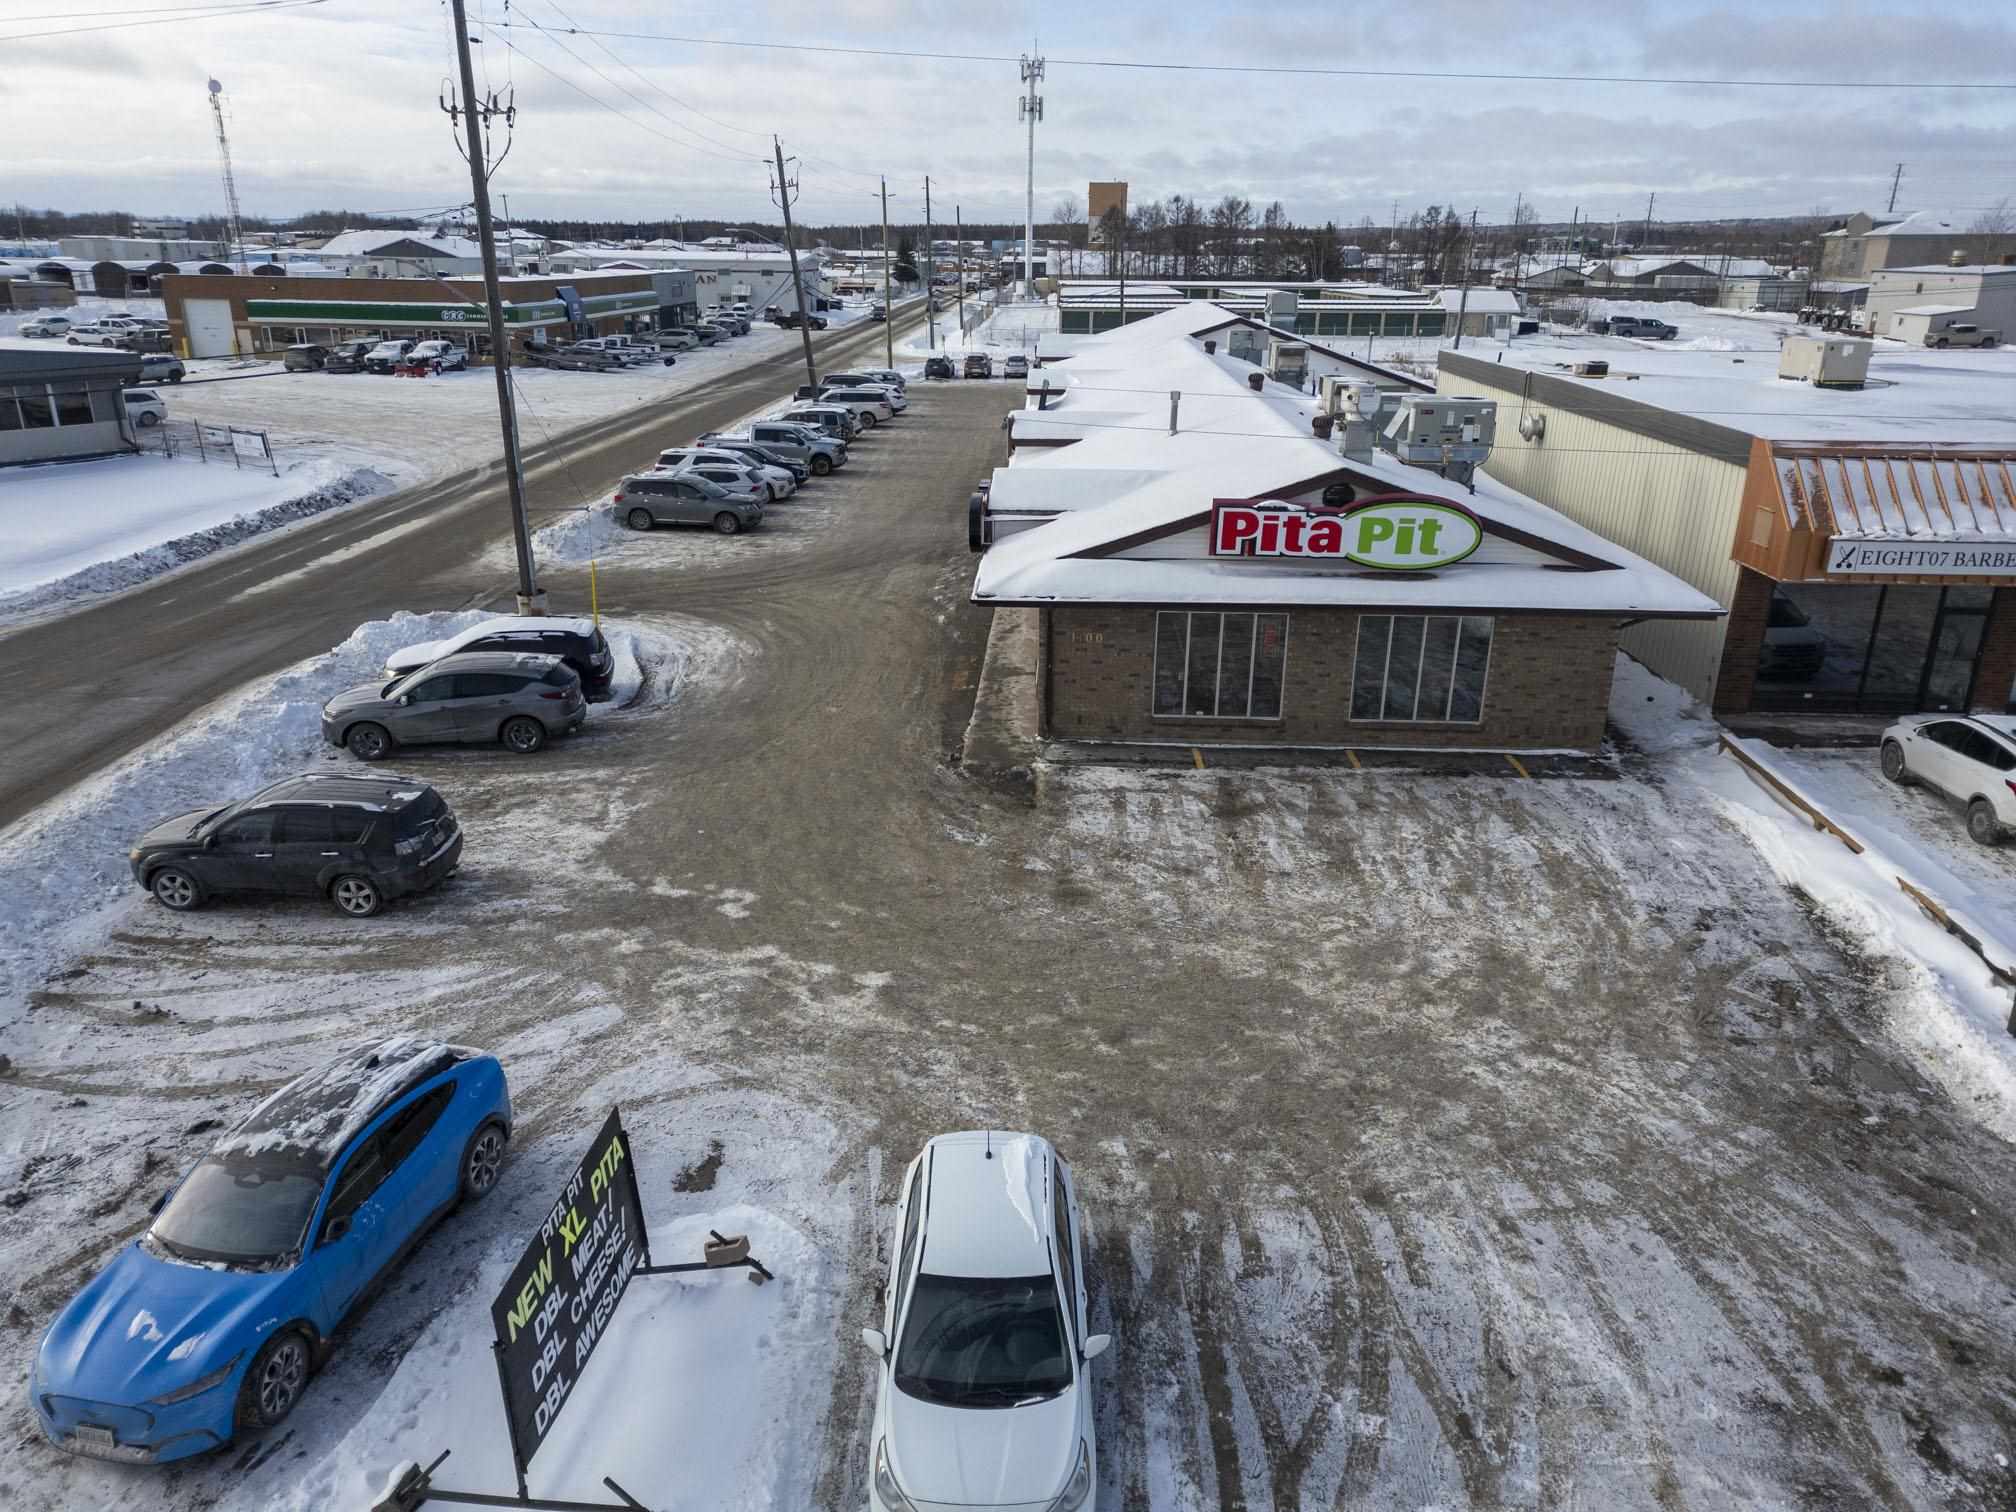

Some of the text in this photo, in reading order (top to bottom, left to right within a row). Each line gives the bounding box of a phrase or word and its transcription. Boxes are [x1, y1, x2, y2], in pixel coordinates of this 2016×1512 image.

[1220, 511, 1443, 556] Pita Pit
[1860, 551, 2016, 568] EIGHT07 BARBE
[506, 1135, 625, 1344] NEW XL PITA
[534, 1187, 613, 1344] DBL MEAT!
[540, 1167, 584, 1247] PITA PIT
[531, 1206, 627, 1393] DBL CHEESE!
[535, 1240, 636, 1437] DBL AWESOME
